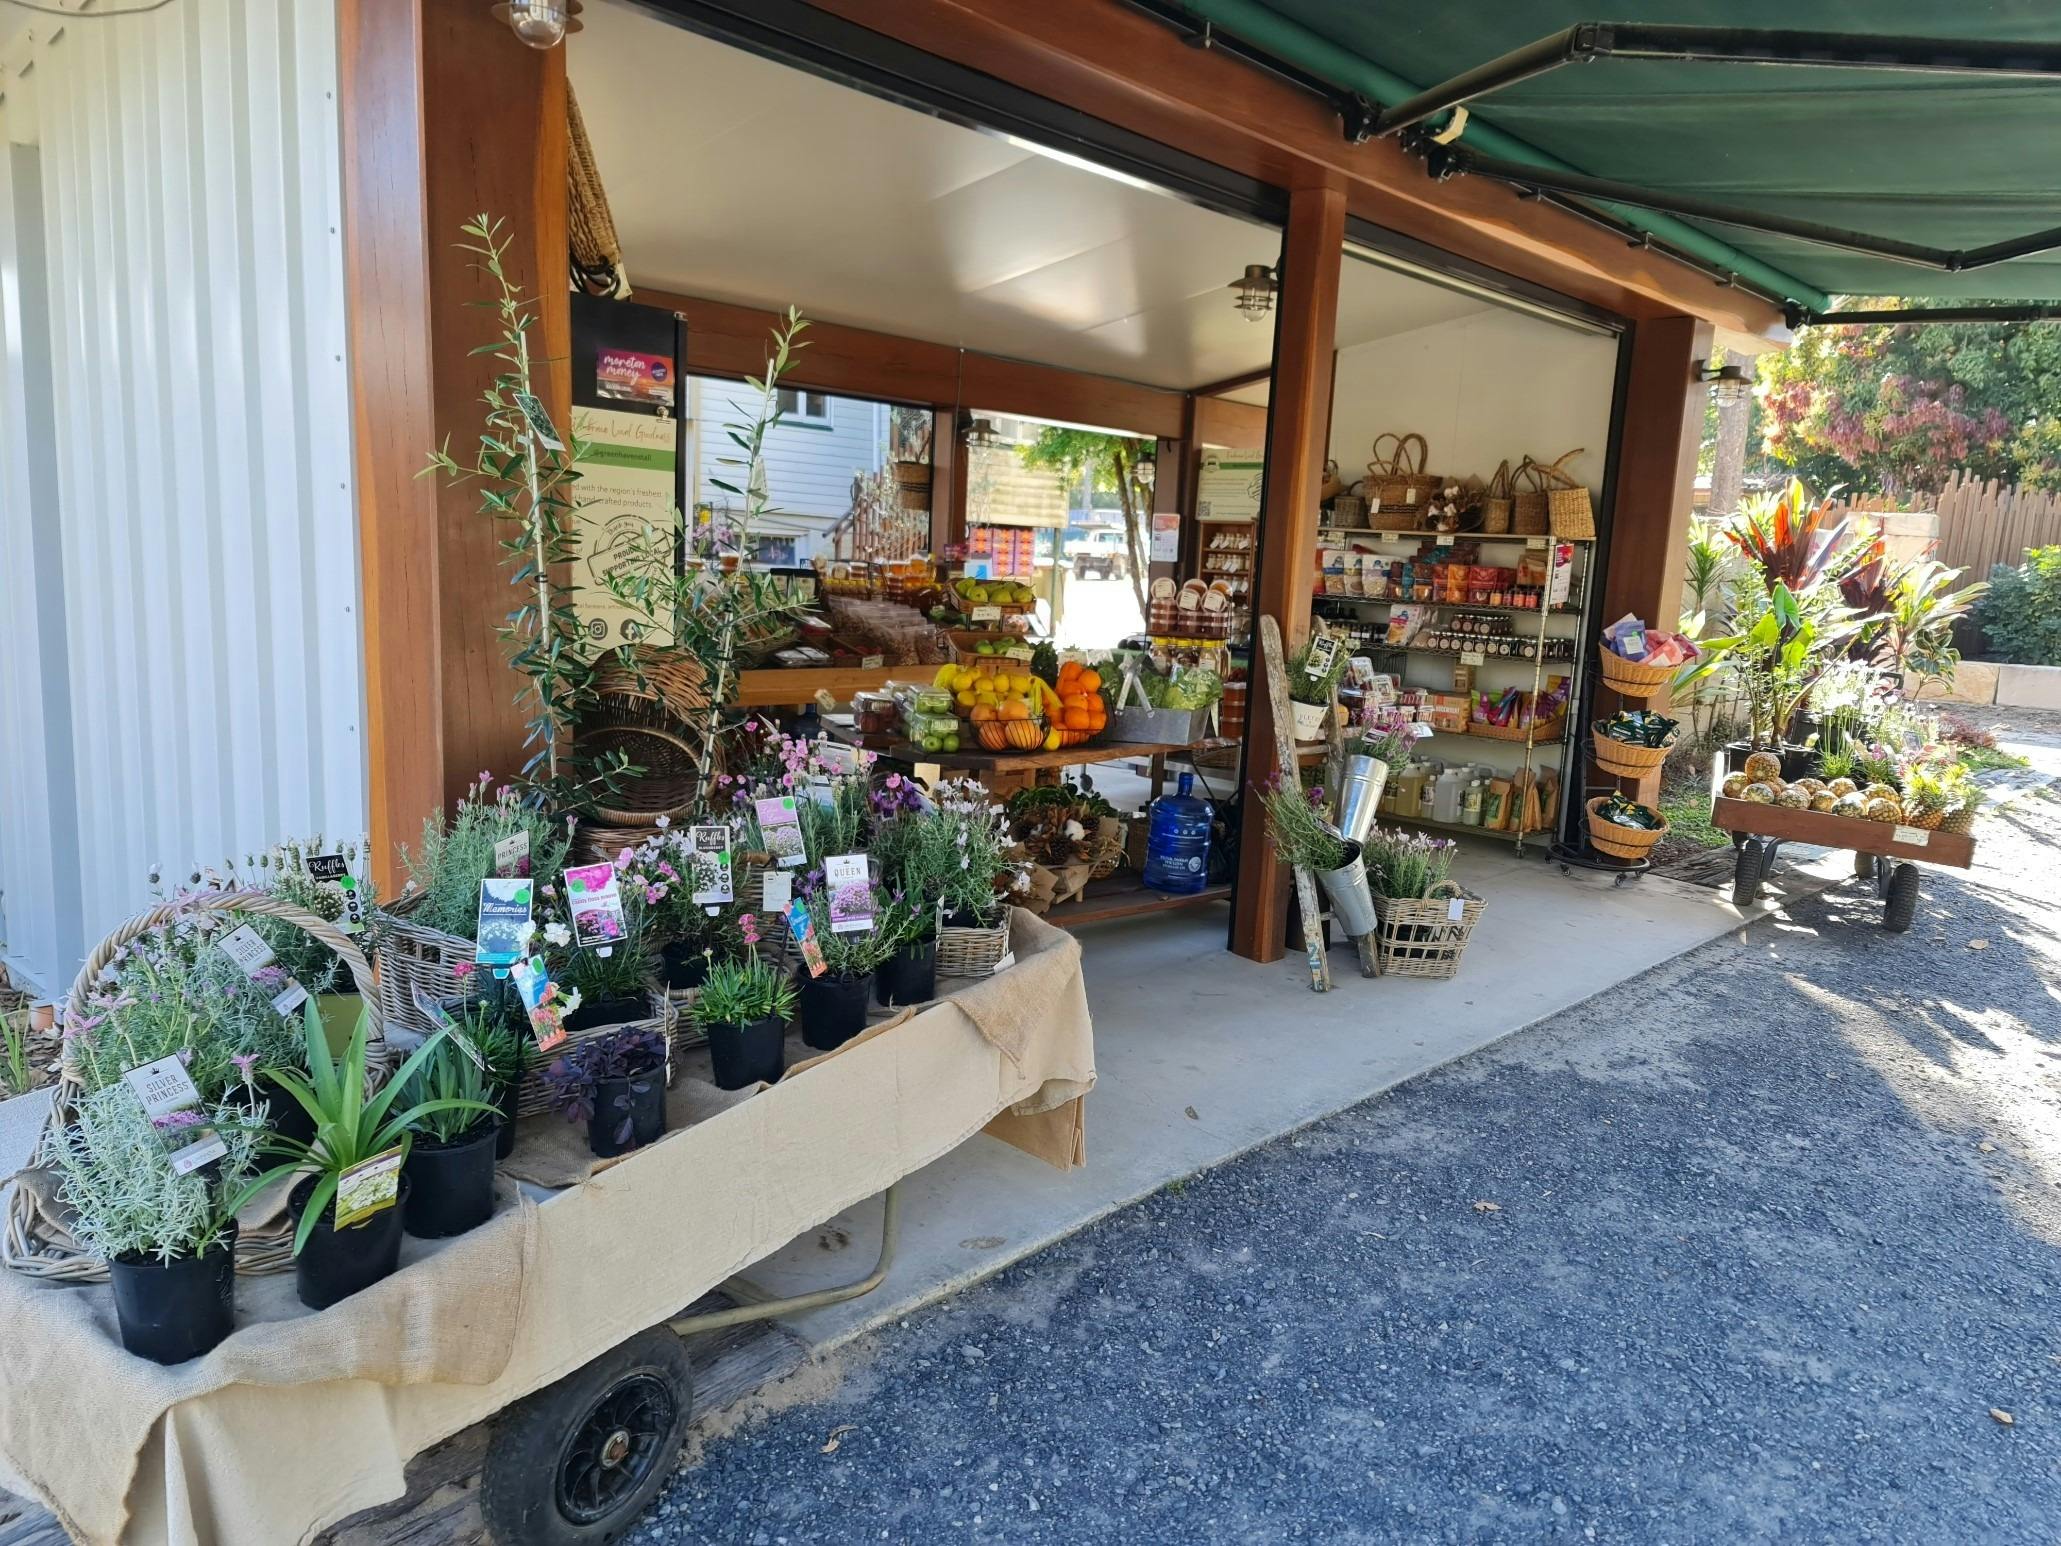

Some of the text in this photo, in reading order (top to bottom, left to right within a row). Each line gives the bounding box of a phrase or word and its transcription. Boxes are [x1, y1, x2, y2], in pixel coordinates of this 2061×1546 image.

[604, 355, 646, 369] moreton
[606, 366, 641, 386] money
[579, 484, 596, 492] with
[597, 486, 609, 494] the
[610, 487, 636, 497] region's
[636, 489, 662, 498] freshest
[696, 830, 725, 846] Ruffles
[497, 842, 528, 861] PRINCESS
[308, 858, 345, 874] Ruffles
[834, 867, 861, 878] QUEEN
[482, 902, 528, 913] Memories
[146, 1074, 178, 1093] SILVER
[145, 1081, 189, 1105] PRINCESS
